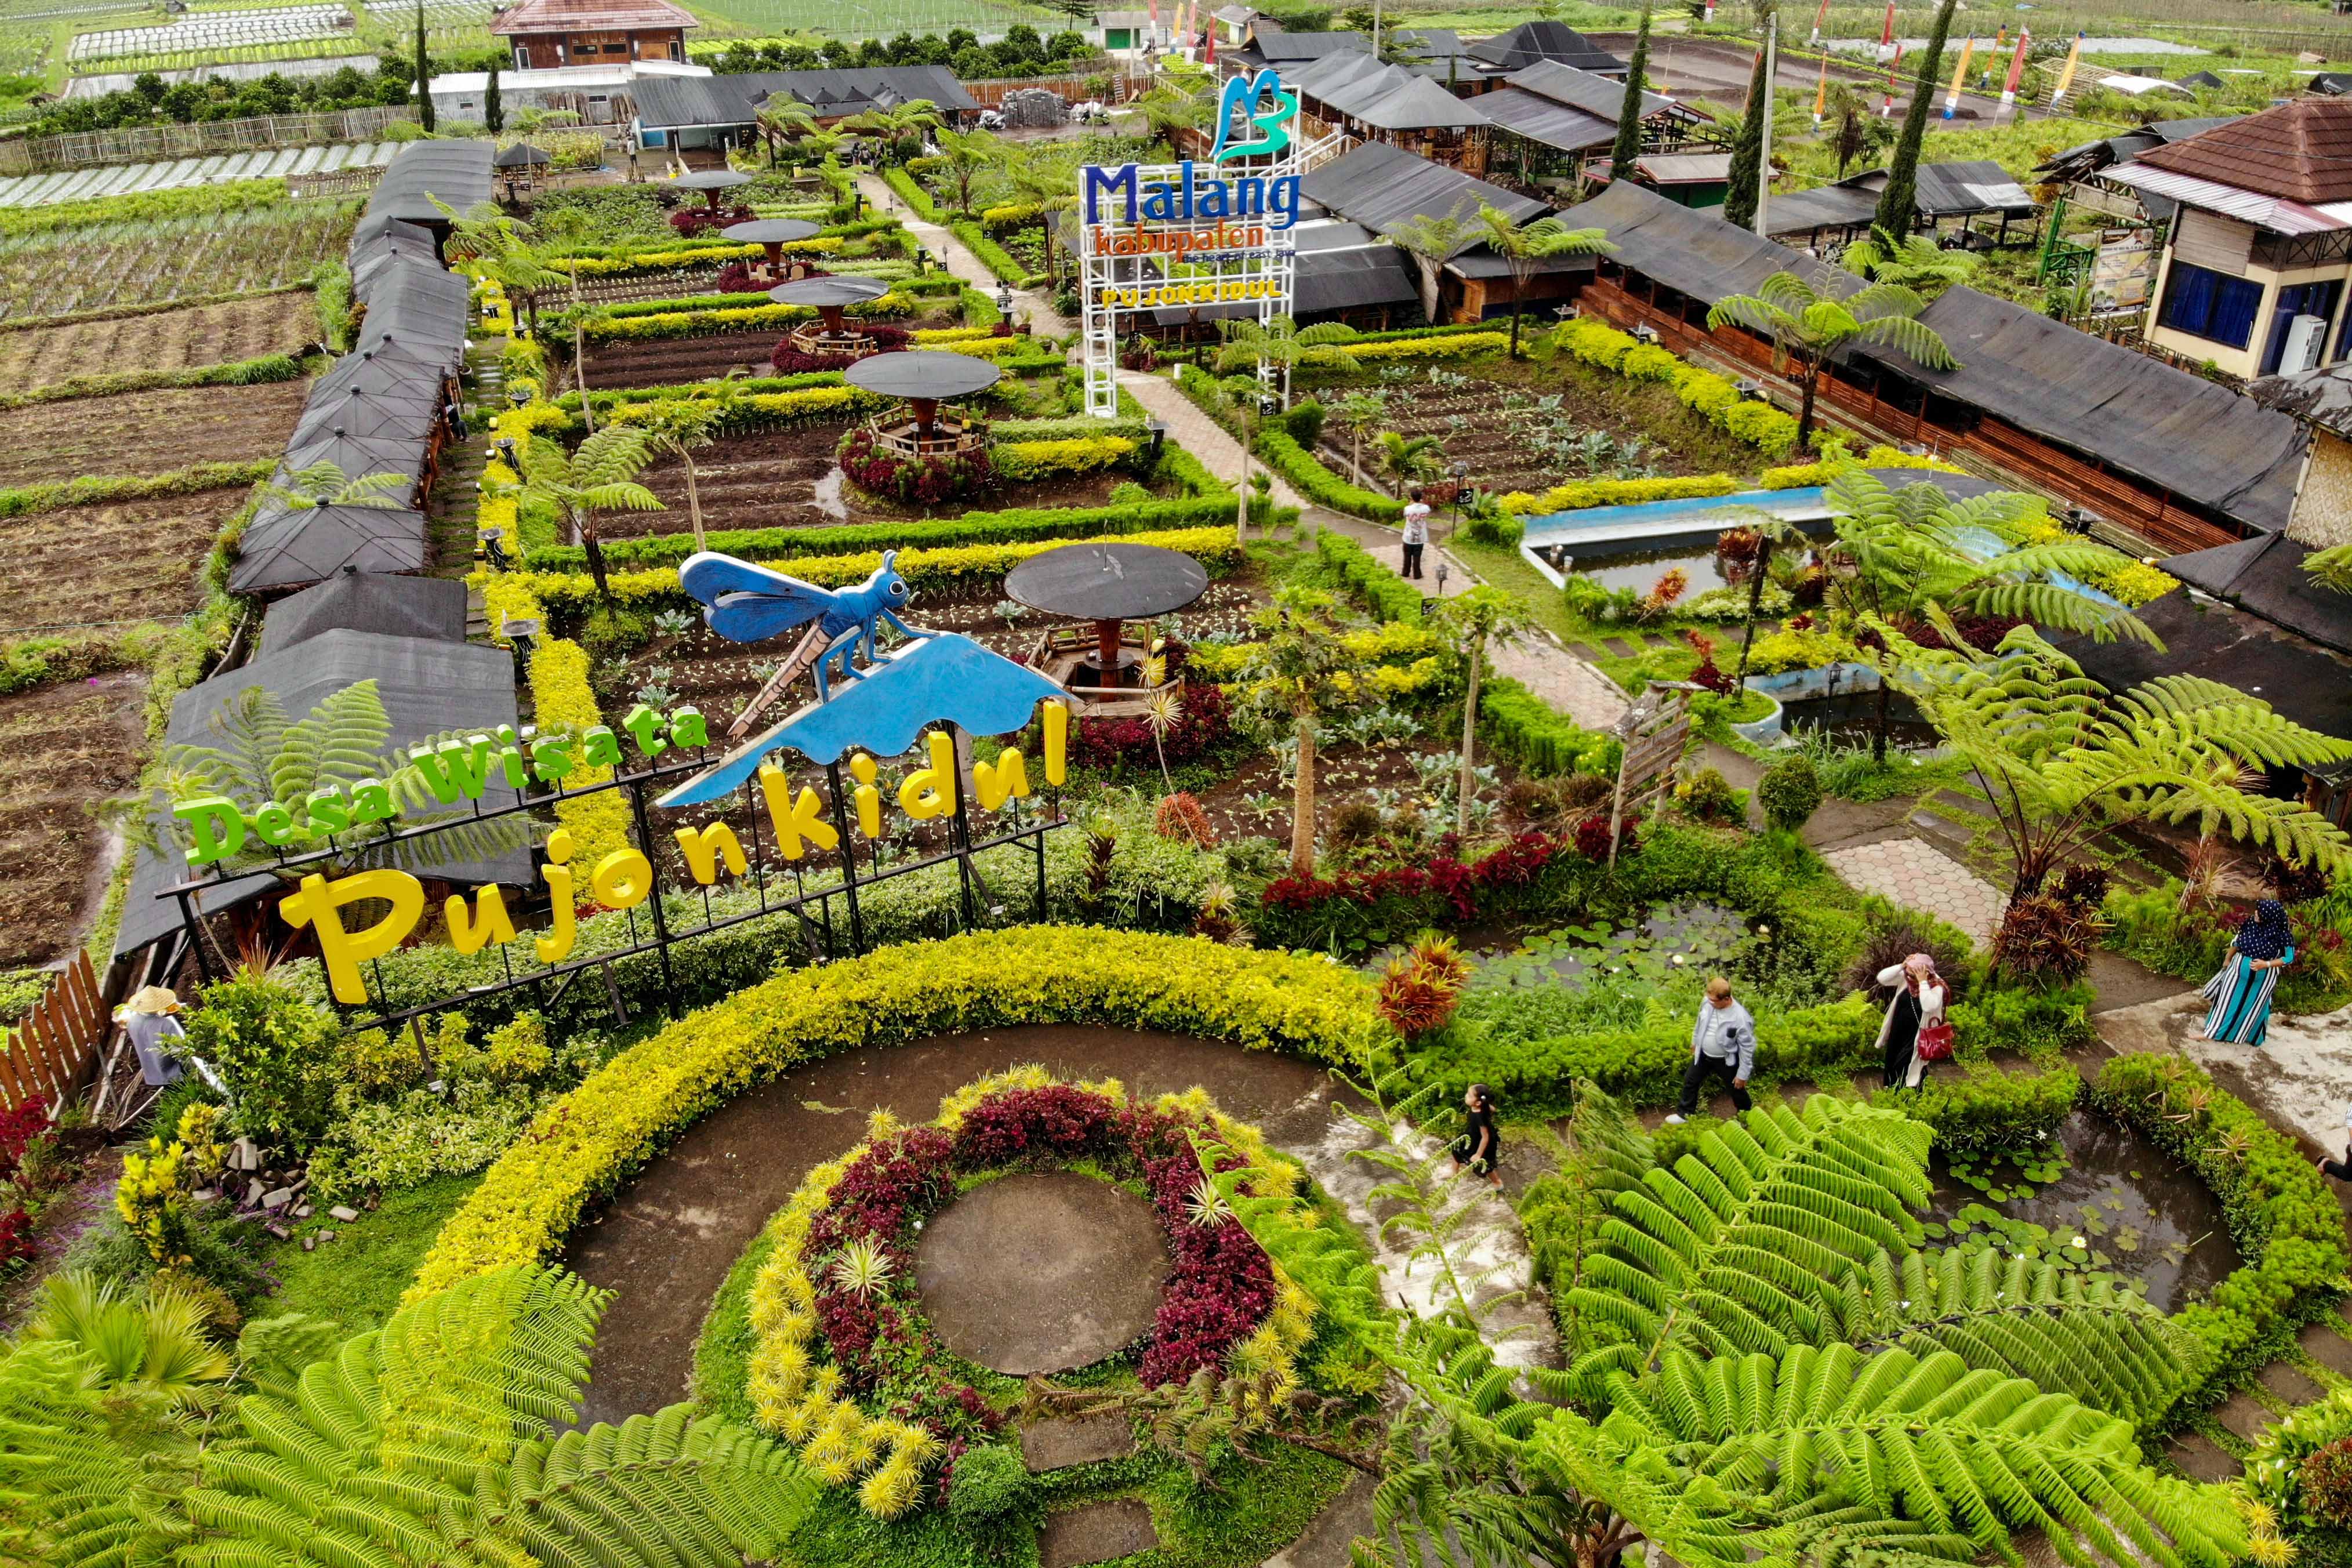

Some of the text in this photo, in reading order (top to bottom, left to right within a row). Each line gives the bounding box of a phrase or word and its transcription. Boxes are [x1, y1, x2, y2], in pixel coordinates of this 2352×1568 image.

[1082, 160, 1301, 229] Malang
[1094, 218, 1264, 263] kabupaten
[1183, 253, 1199, 263] the
[1202, 251, 1230, 261] heart
[1234, 250, 1245, 260] of
[1249, 249, 1271, 259] east
[1102, 279, 1282, 308] PUJONKIDUL
[173, 703, 710, 865] Desa Wisata
